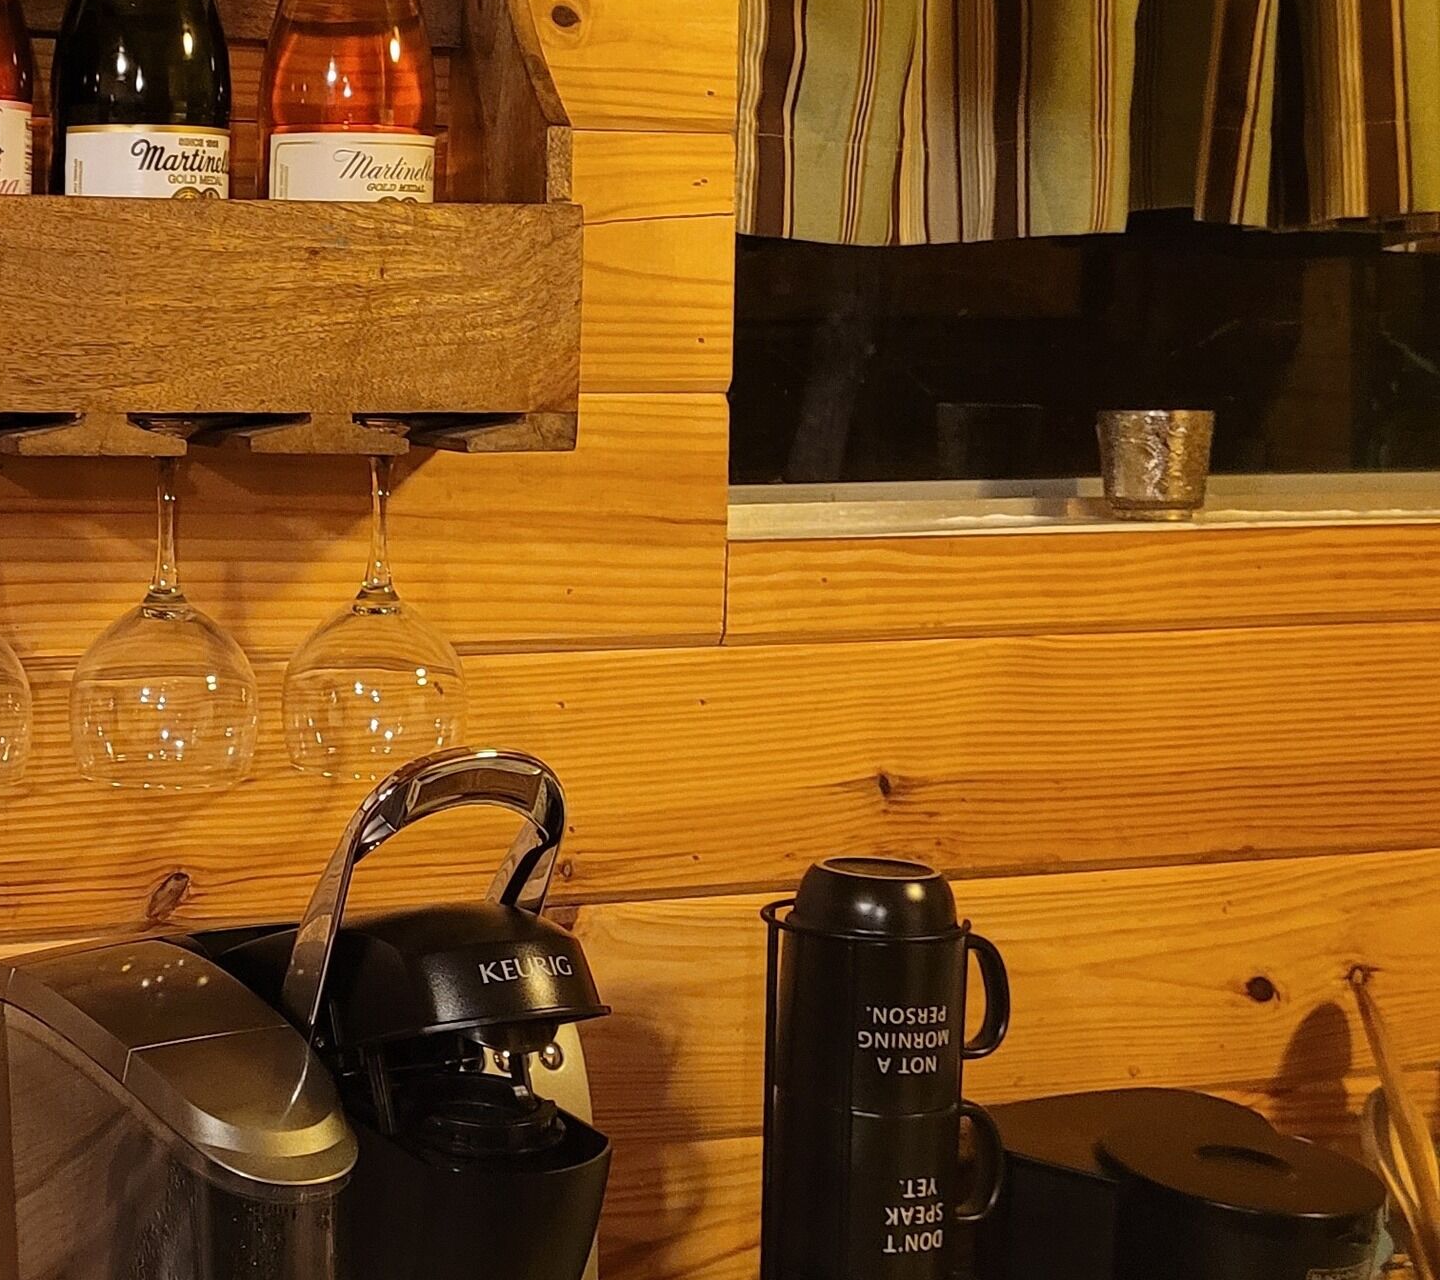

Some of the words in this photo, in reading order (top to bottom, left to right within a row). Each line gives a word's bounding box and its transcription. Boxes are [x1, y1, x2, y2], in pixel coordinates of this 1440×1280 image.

[168, 174, 196, 184] GOLD
[366, 183, 397, 192] GOLD
[478, 956, 573, 984] KEURIG
[866, 1005, 946, 1025] PERSON.
[858, 1029, 950, 1049] MORNING
[876, 1056, 892, 1074] A
[897, 1056, 936, 1074] NOT
[898, 1177, 938, 1198] YET.
[884, 1202, 944, 1226] SPEAK
[882, 1228, 944, 1254] DON'T
